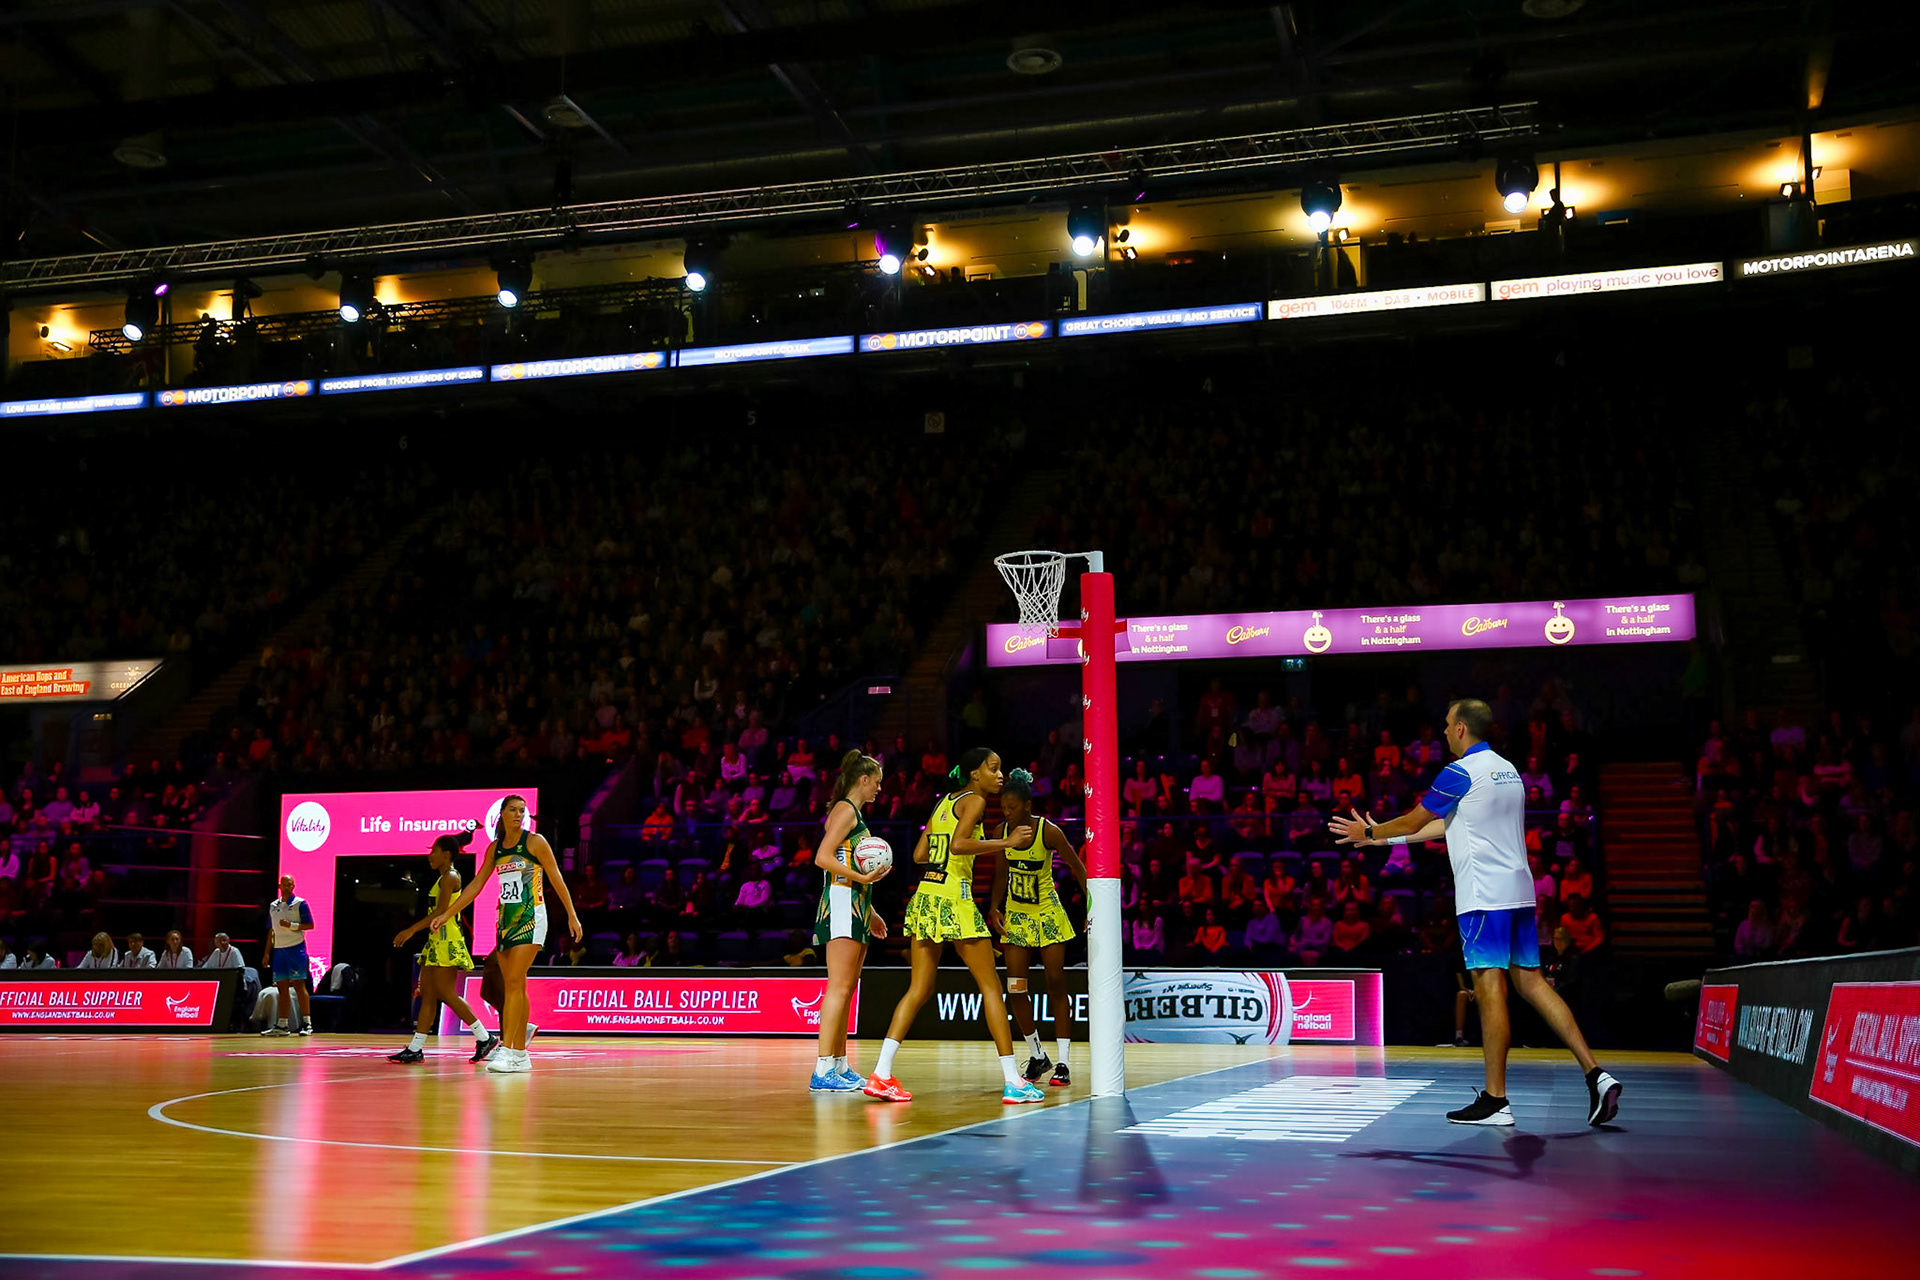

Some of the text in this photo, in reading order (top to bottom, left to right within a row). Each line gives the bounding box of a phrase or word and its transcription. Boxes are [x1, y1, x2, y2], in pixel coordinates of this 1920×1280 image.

[1743, 243, 1914, 275] MOTORPOINTARENA
[1499, 263, 1719, 300] gem playing music you love
[1279, 288, 1475, 318] gem 106FM DAB MOBILE
[1065, 306, 1256, 332] GREAT CHOICE, VALUE AND SERVICE
[900, 325, 1012, 347] MOTORPOINT
[527, 356, 628, 377] MOTORPOINT
[323, 370, 483, 391] CHOOSE FROM THOUSANDS OF CARS
[187, 384, 281, 403] MOTORPOINT
[6, 405, 25, 414] LOW
[1605, 604, 1638, 613] There's
[1648, 602, 1670, 616] glass
[1361, 615, 1391, 624] There's
[1399, 614, 1421, 626] glass
[1461, 617, 1508, 636] Cadbury
[1621, 615, 1629, 624] &
[1637, 614, 1655, 623] half
[1131, 624, 1160, 633] There's
[1167, 623, 1188, 634] glass
[1226, 625, 1269, 645] Cadbury
[1375, 625, 1382, 634] &
[1390, 624, 1406, 633] half
[1606, 624, 1671, 638] in Nottingham
[1004, 635, 1046, 654] Cadbury
[1145, 634, 1152, 643] &
[1160, 633, 1175, 642] half
[1361, 634, 1421, 647] in Nottingham
[1132, 643, 1188, 655] in Nottingham
[1, 670, 67, 684] American Hops and
[1, 681, 85, 696] East of England Brewing
[291, 816, 326, 837] Vitality
[360, 816, 391, 833] Life
[399, 817, 477, 832] insurance
[928, 834, 948, 864] GD
[501, 881, 519, 900] GA
[1012, 873, 1037, 900] GK
[0, 991, 143, 1006] FFICIAL BALL SUPPLIER
[558, 989, 759, 1009] OFFICIAL BALL SUPPLIER
[12, 1011, 116, 1019] WWW.ENGLANDNETBALL.CO.UK
[174, 1005, 200, 1014] England
[1124, 994, 1263, 1022] GILBERT
[587, 1014, 725, 1025] WWW.ENGLANDNETBALL.CO.UK
[1293, 1013, 1332, 1023] England
[1297, 1020, 1332, 1030] netball
